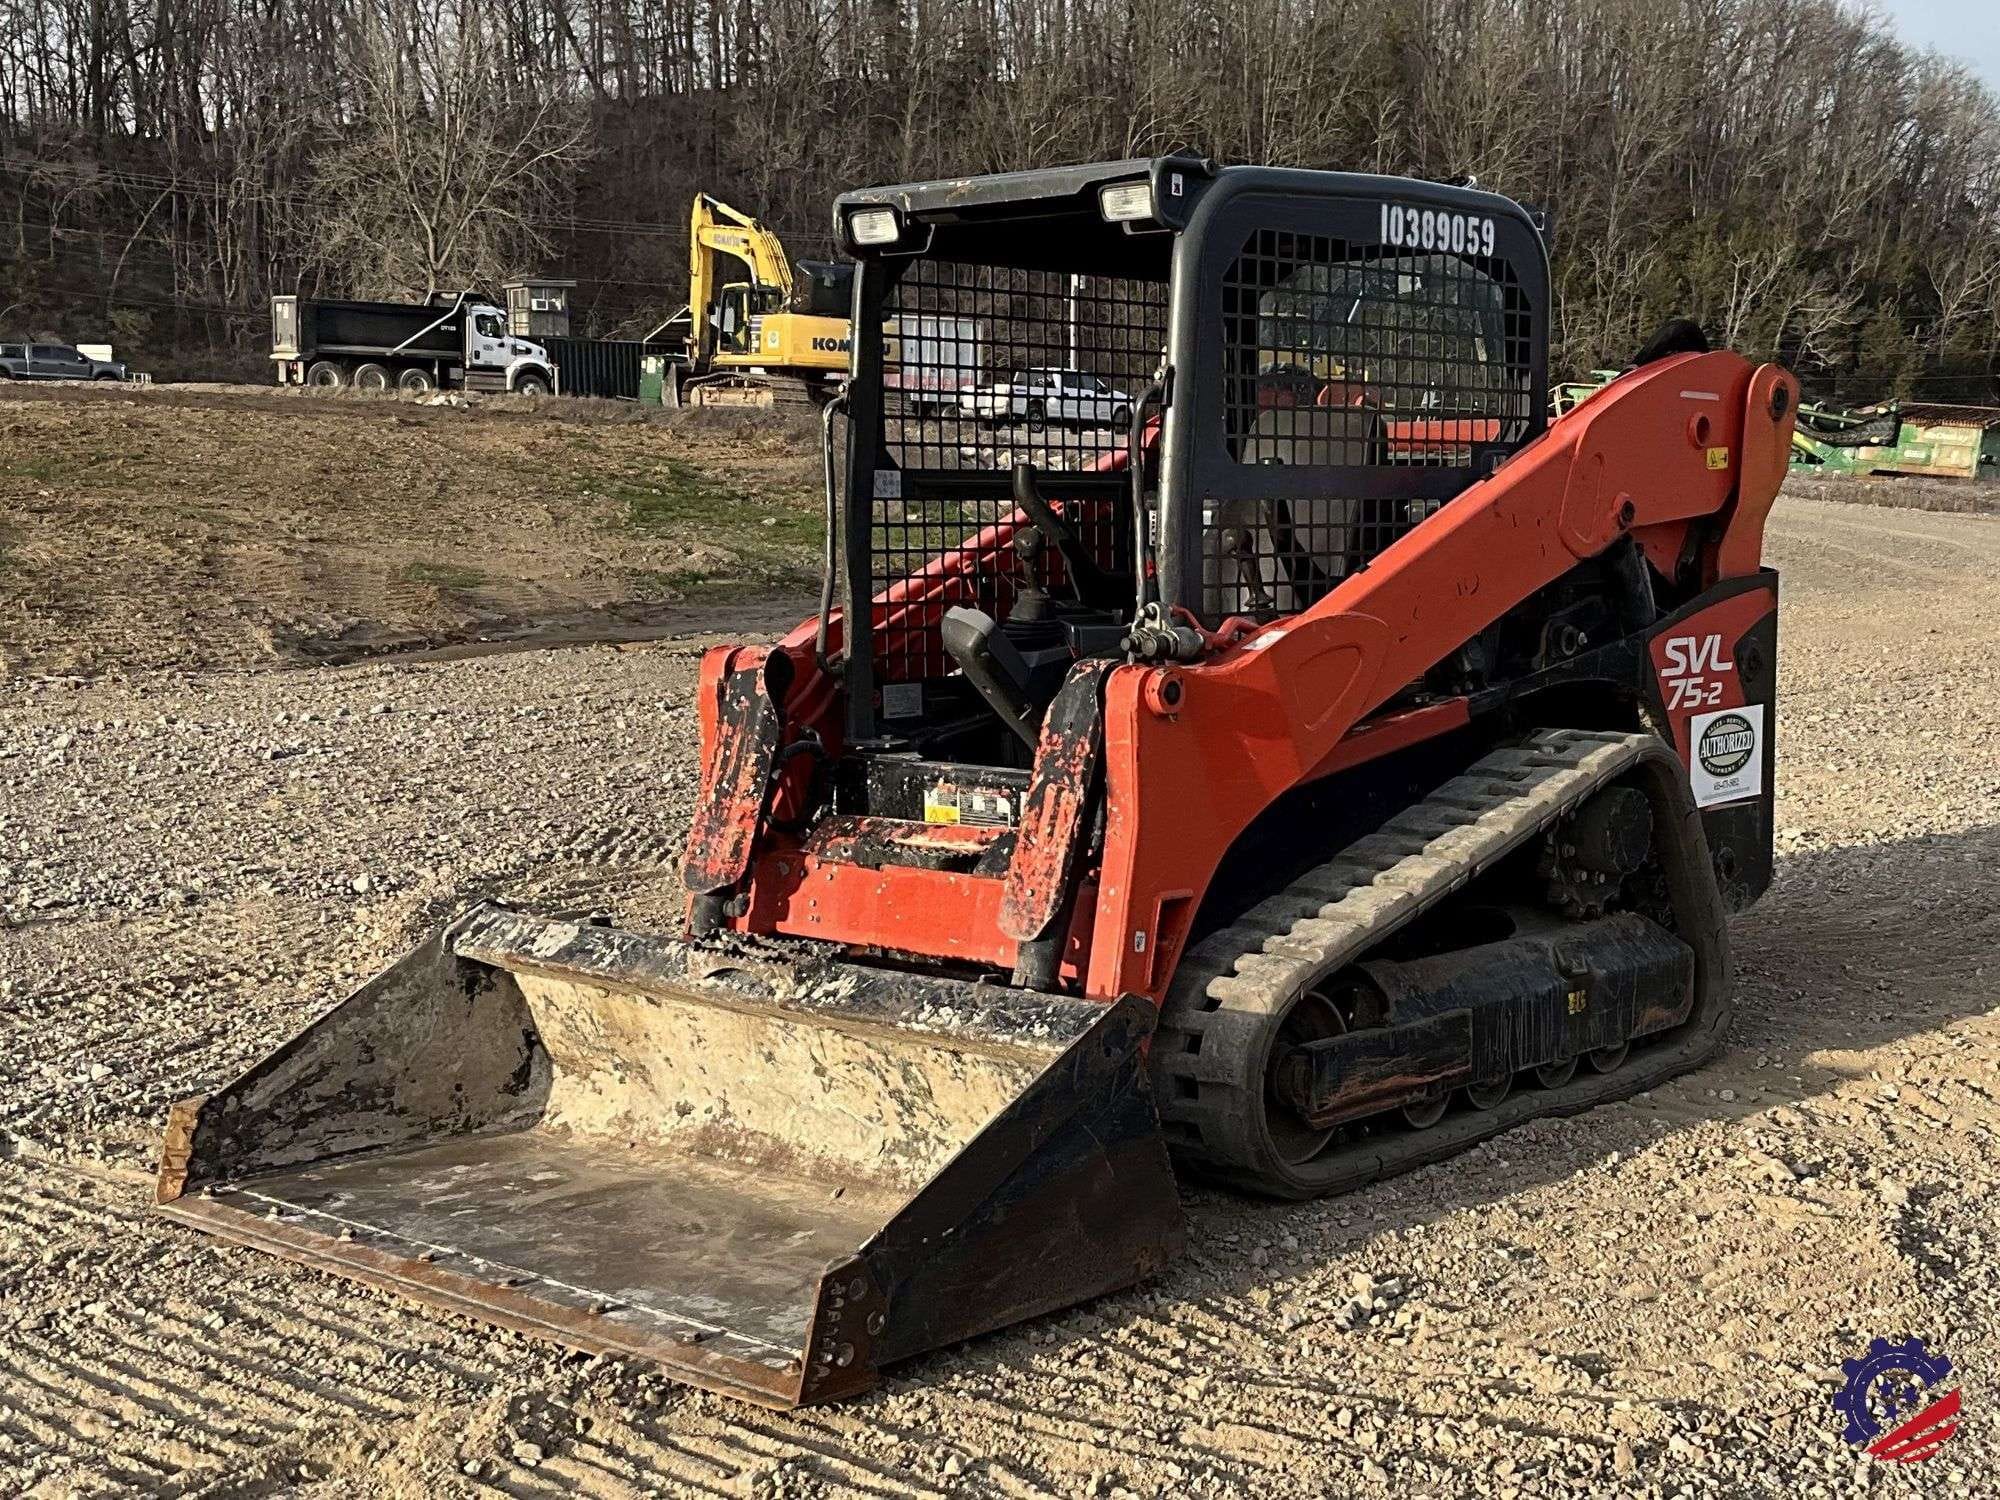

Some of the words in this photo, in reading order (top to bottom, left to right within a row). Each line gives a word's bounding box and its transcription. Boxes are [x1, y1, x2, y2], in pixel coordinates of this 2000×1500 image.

[1381, 203, 1495, 257] 10389059
[1661, 634, 1734, 677] SVL
[1667, 677, 1723, 711] 75-2
[1700, 730, 1753, 759] AUTHORIZED
